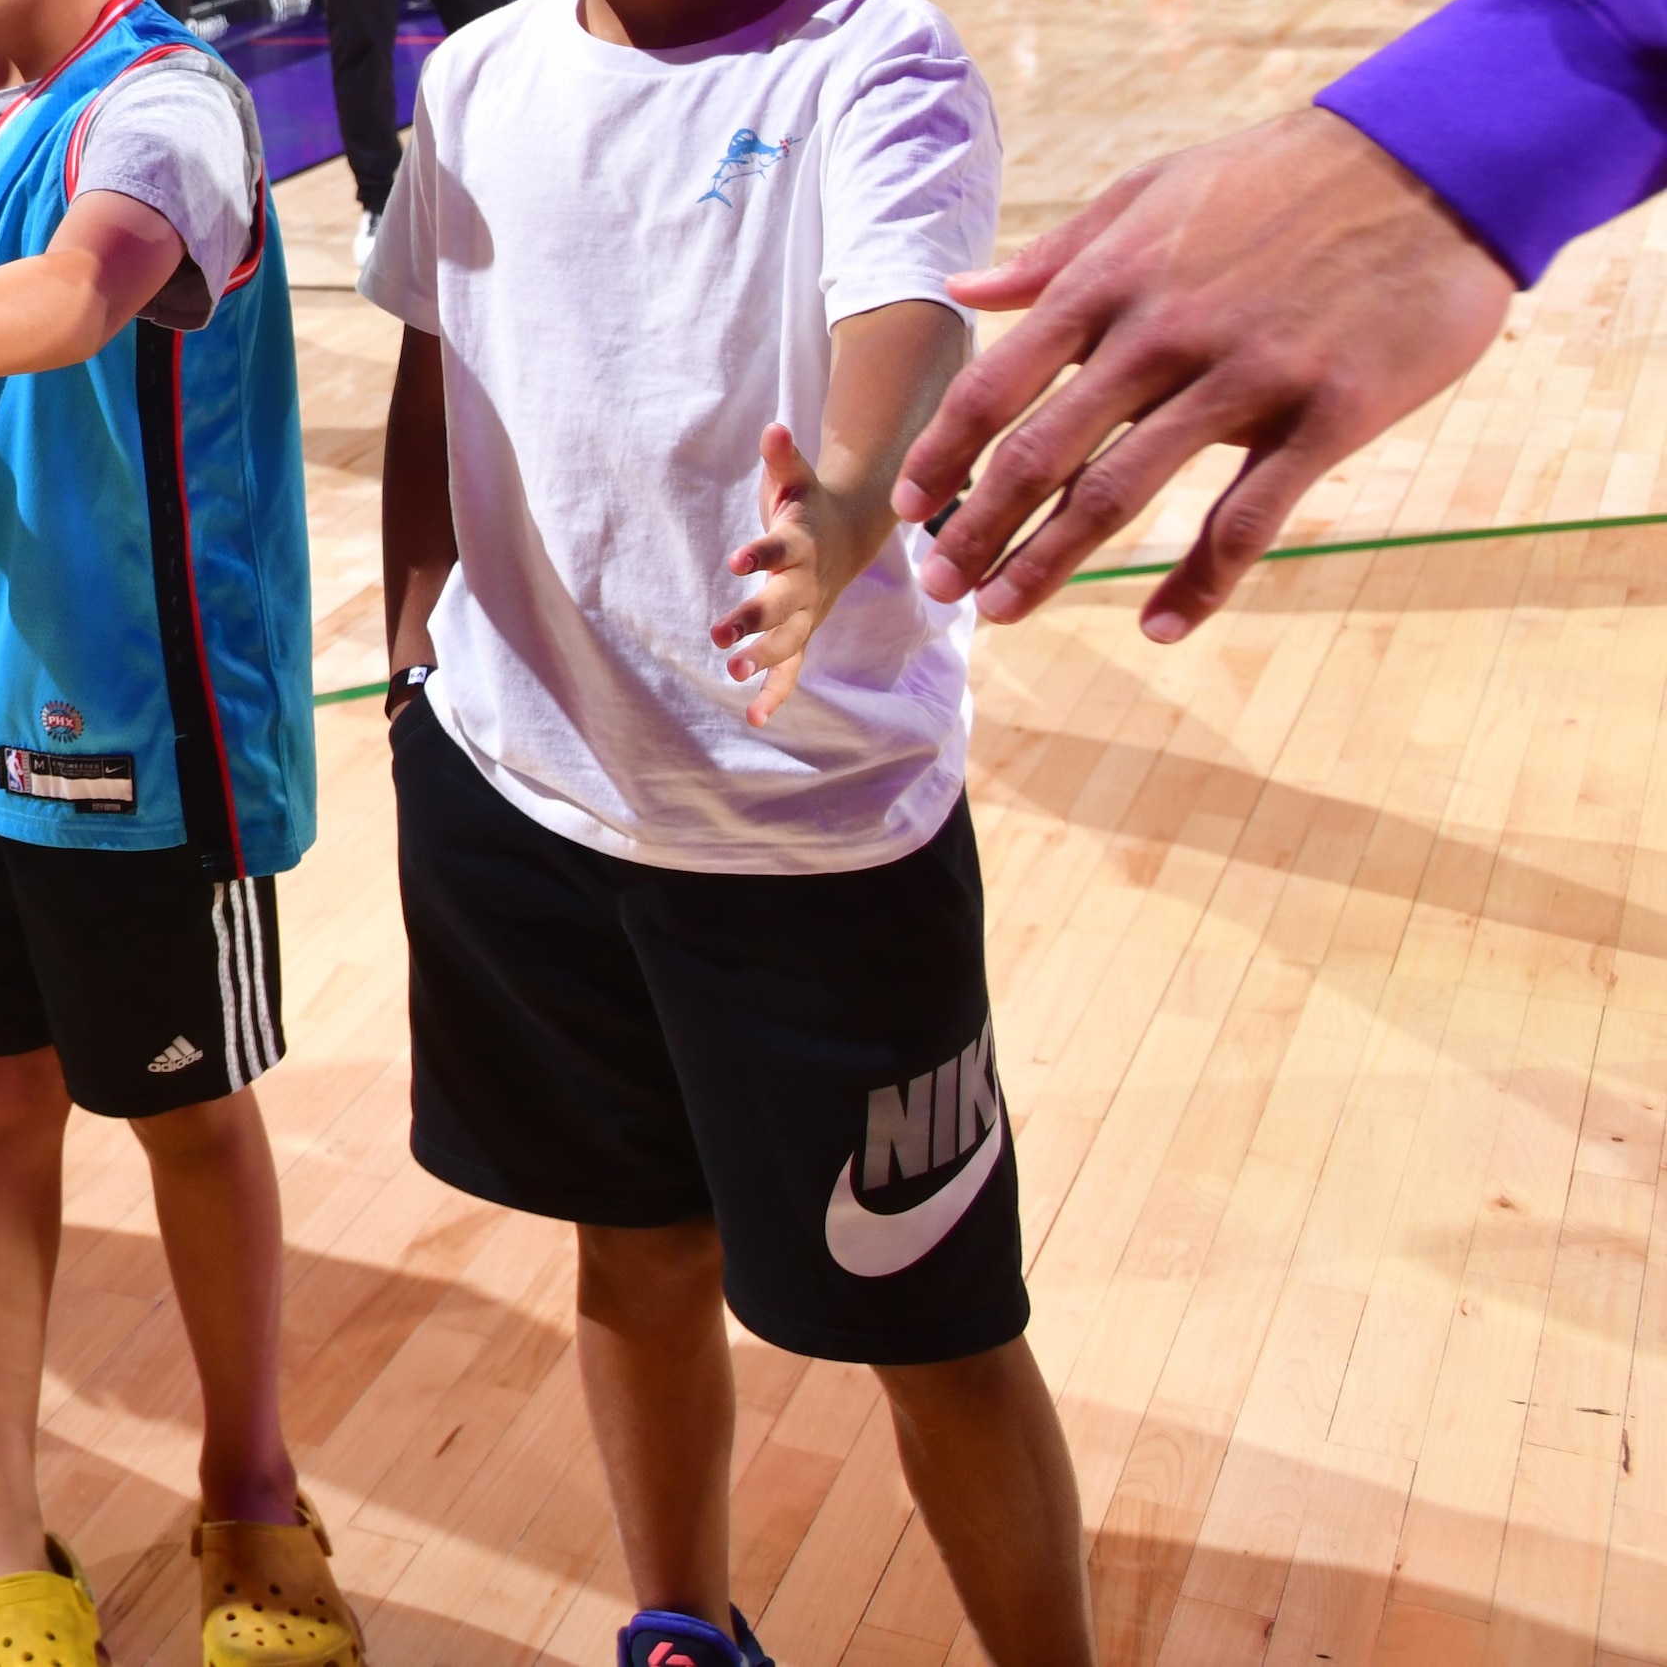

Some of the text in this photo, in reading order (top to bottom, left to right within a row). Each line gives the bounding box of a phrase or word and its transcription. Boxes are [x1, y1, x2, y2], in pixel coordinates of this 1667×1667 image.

[47, 714, 75, 728] PHX
[33, 759, 45, 771] M
[147, 1049, 204, 1073] adidas
[862, 1006, 997, 1191] NIK
